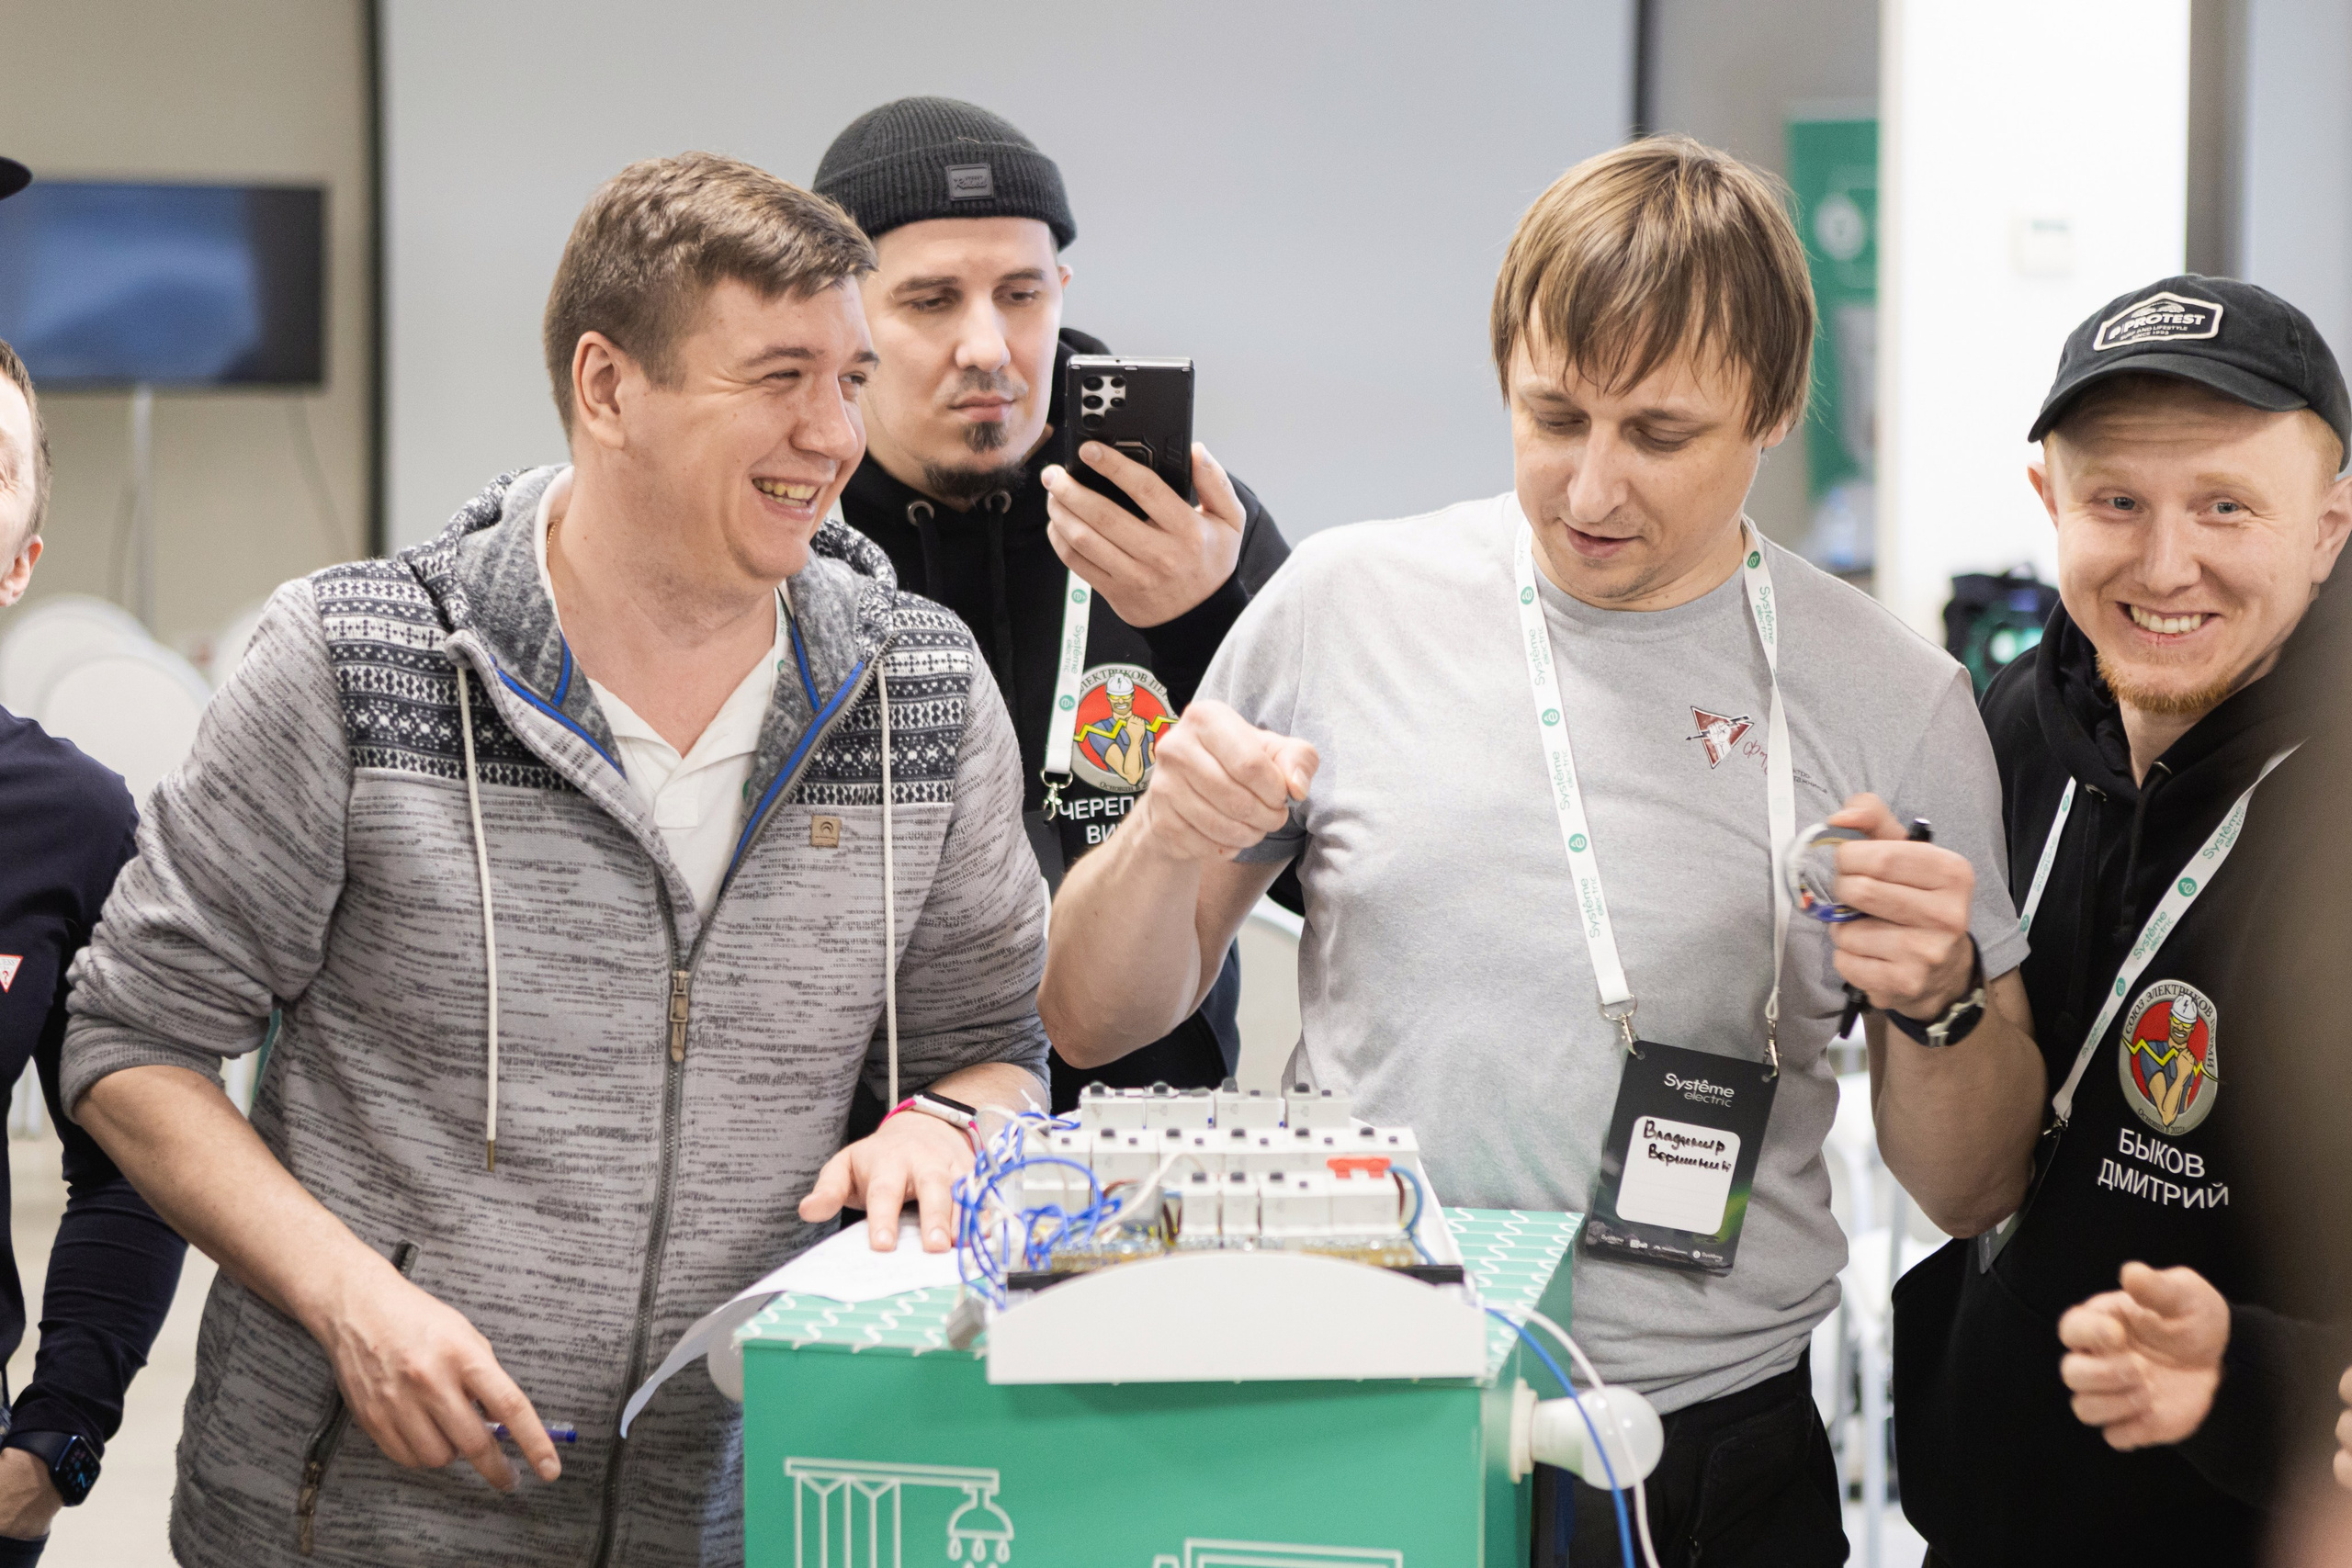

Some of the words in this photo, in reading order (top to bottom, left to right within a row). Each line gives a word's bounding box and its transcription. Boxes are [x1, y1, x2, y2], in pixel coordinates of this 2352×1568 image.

[2123, 313, 2206, 333] PROTEST
[1755, 604, 1769, 644] electric
[1063, 638, 1073, 673] electric
[1537, 626, 1550, 665] electric
[1563, 749, 1574, 788] electric
[1059, 795, 1135, 820] ЧЕРЕП
[2225, 810, 2245, 848] electric
[1591, 875, 1605, 917] electric
[2150, 917, 2174, 952] electric
[2125, 998, 2144, 1034] СОЮЗ
[1684, 1090, 1733, 1108] electric
[2120, 1128, 2205, 1179] БЫКОВ
[2097, 1158, 2229, 1210] ДМИТРИЙ
